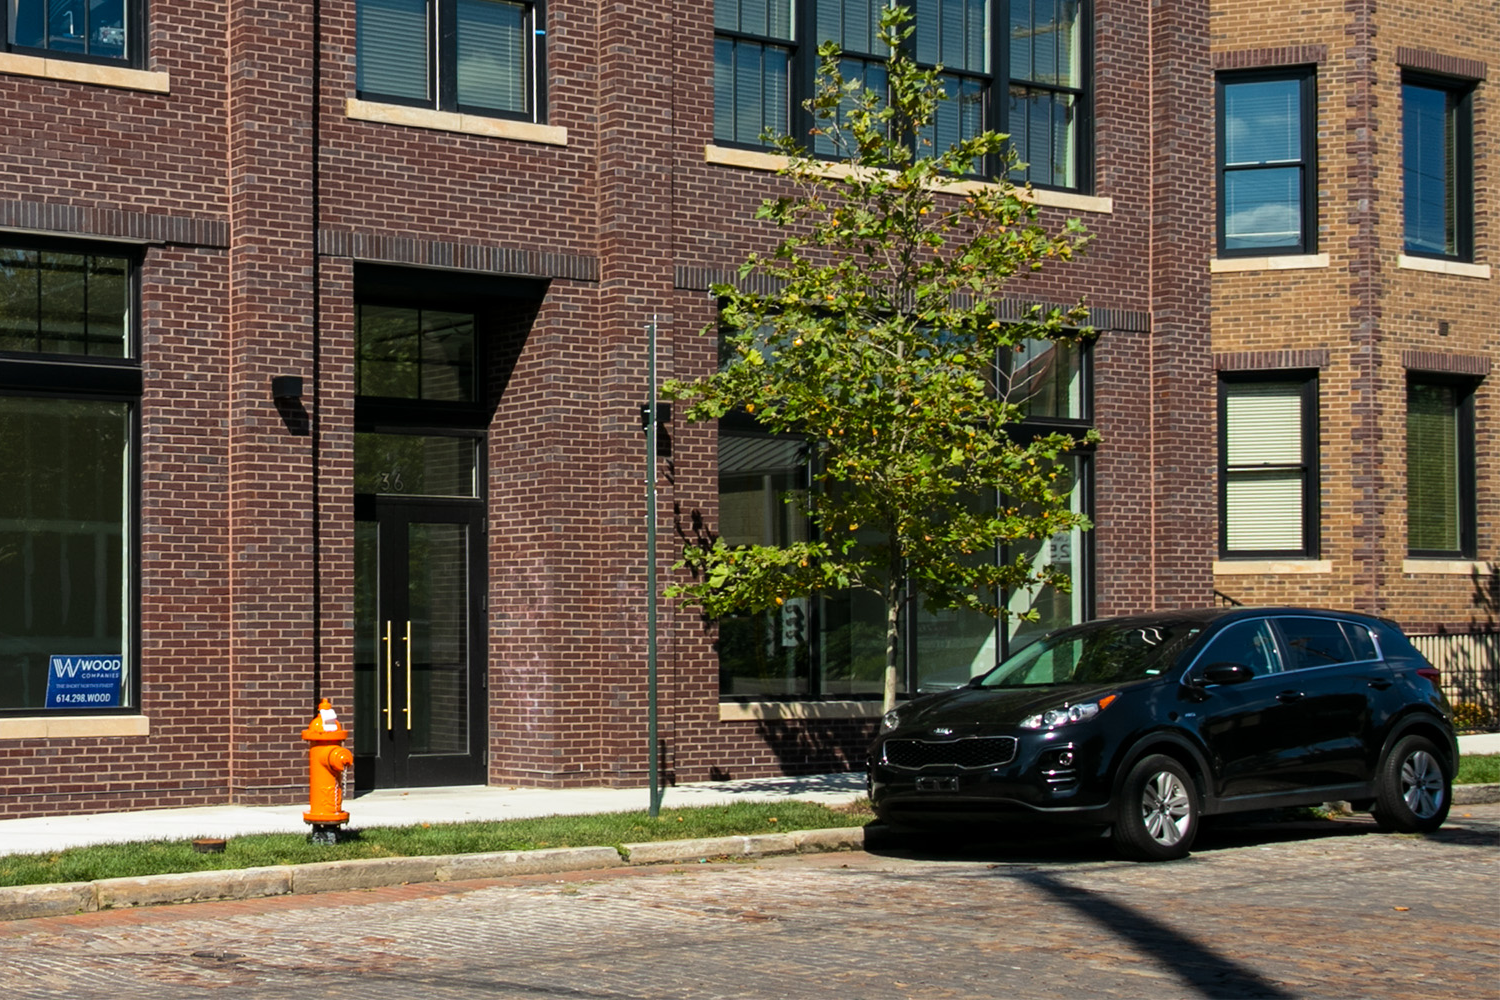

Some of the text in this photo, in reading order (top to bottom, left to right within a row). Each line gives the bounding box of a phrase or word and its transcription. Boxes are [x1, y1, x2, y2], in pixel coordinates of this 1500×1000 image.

[381, 473, 404, 491] 36
[81, 659, 121, 671] WOOD
[56, 693, 111, 703] 614.298.WOOD
